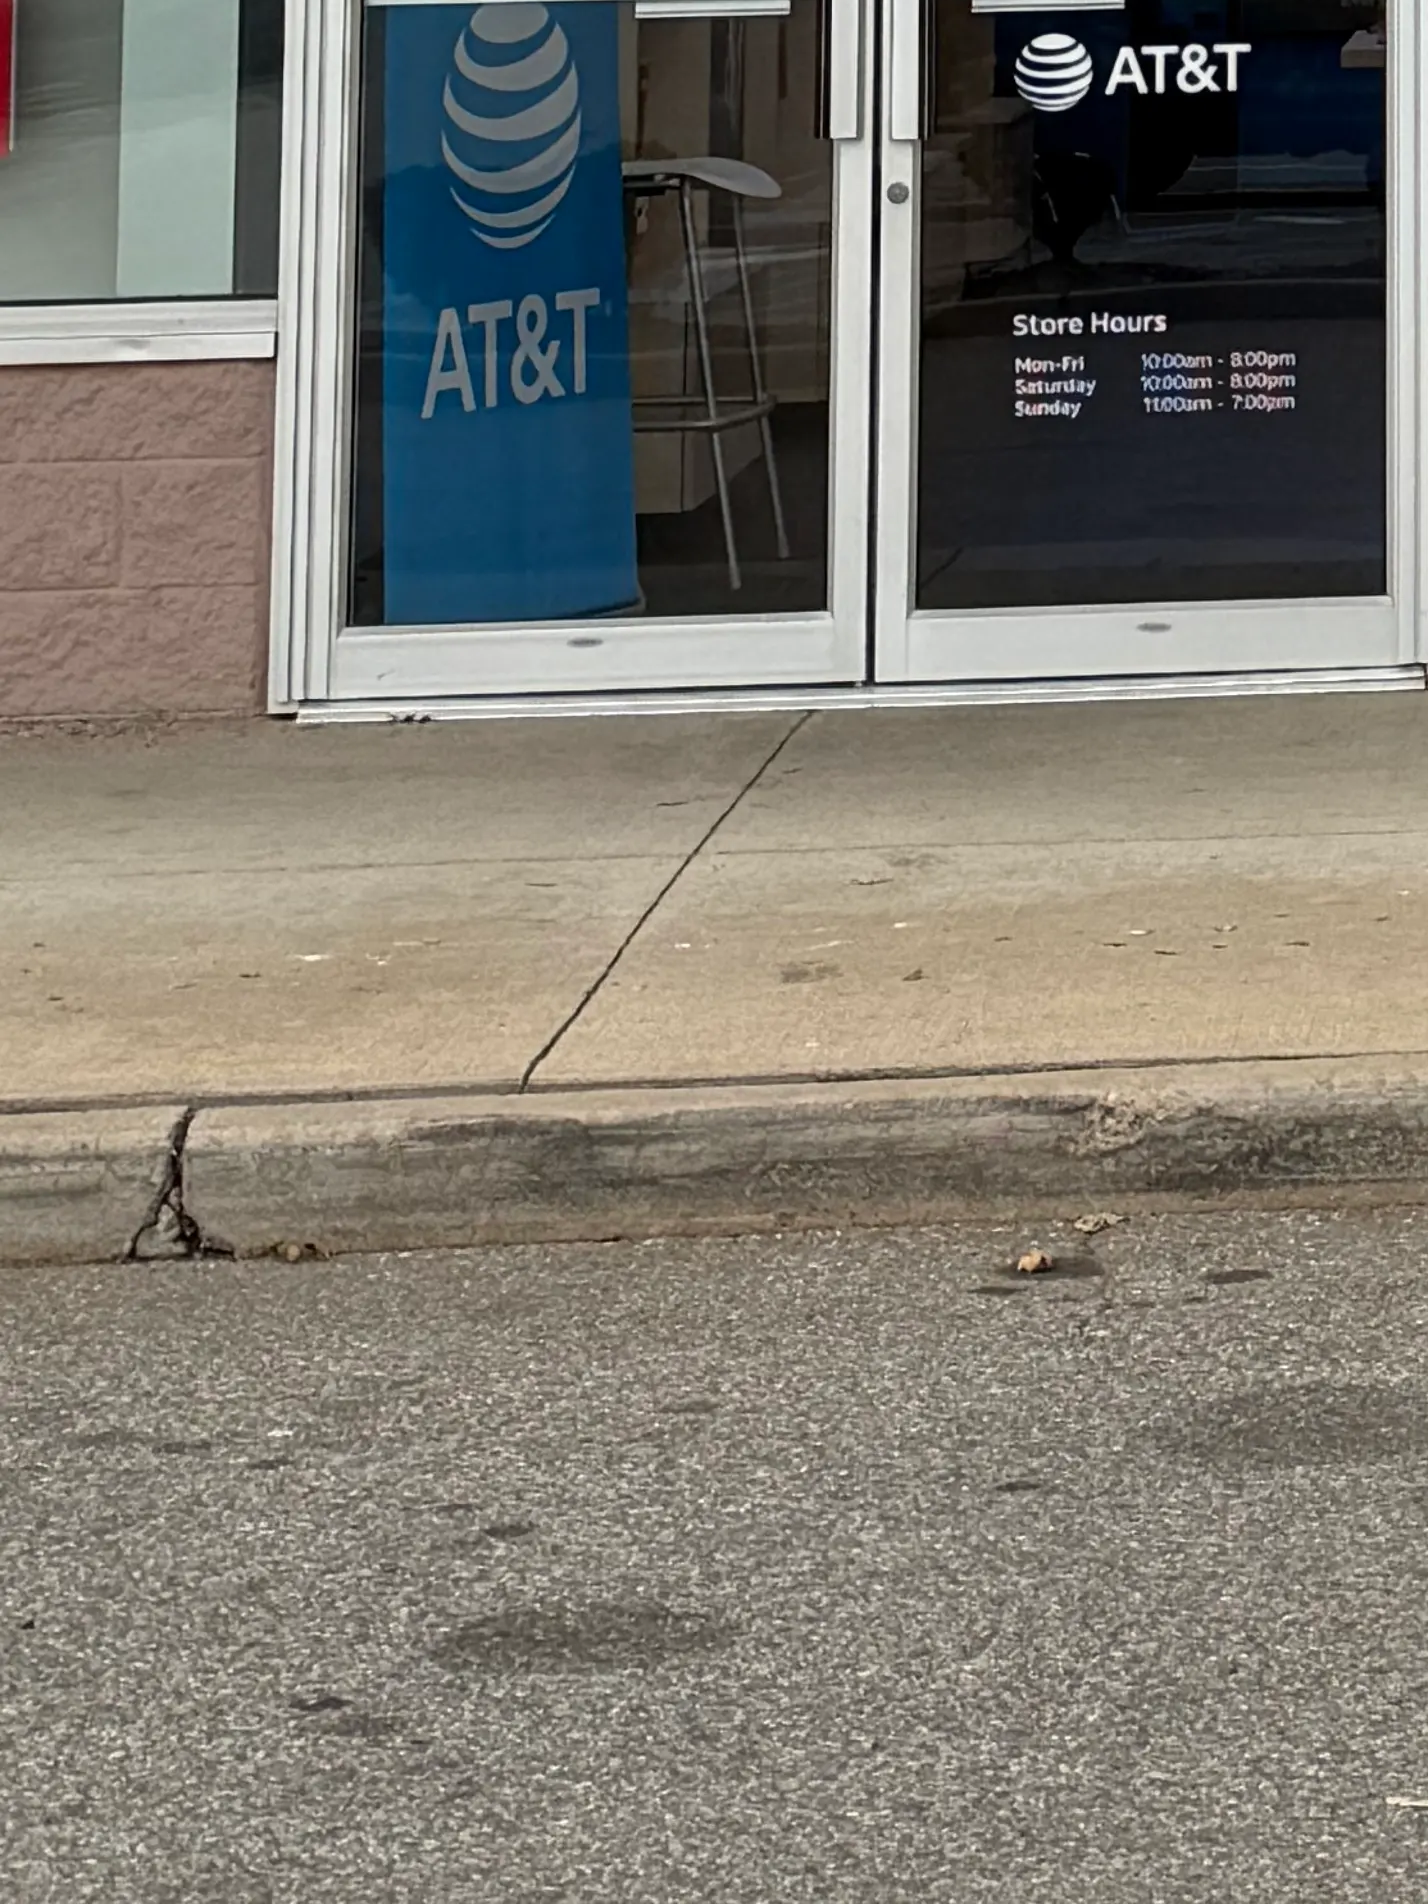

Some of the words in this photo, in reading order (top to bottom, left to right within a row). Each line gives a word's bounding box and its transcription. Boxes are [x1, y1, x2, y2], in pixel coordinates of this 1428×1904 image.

[1105, 43, 1252, 96] AT&T
[1012, 314, 1084, 336] Store
[1091, 312, 1168, 334] Hours
[420, 286, 601, 421] AT&T
[1014, 355, 1085, 374] Mon-Fri
[1015, 378, 1097, 397] Saturday
[1015, 400, 1082, 418] Sunday
